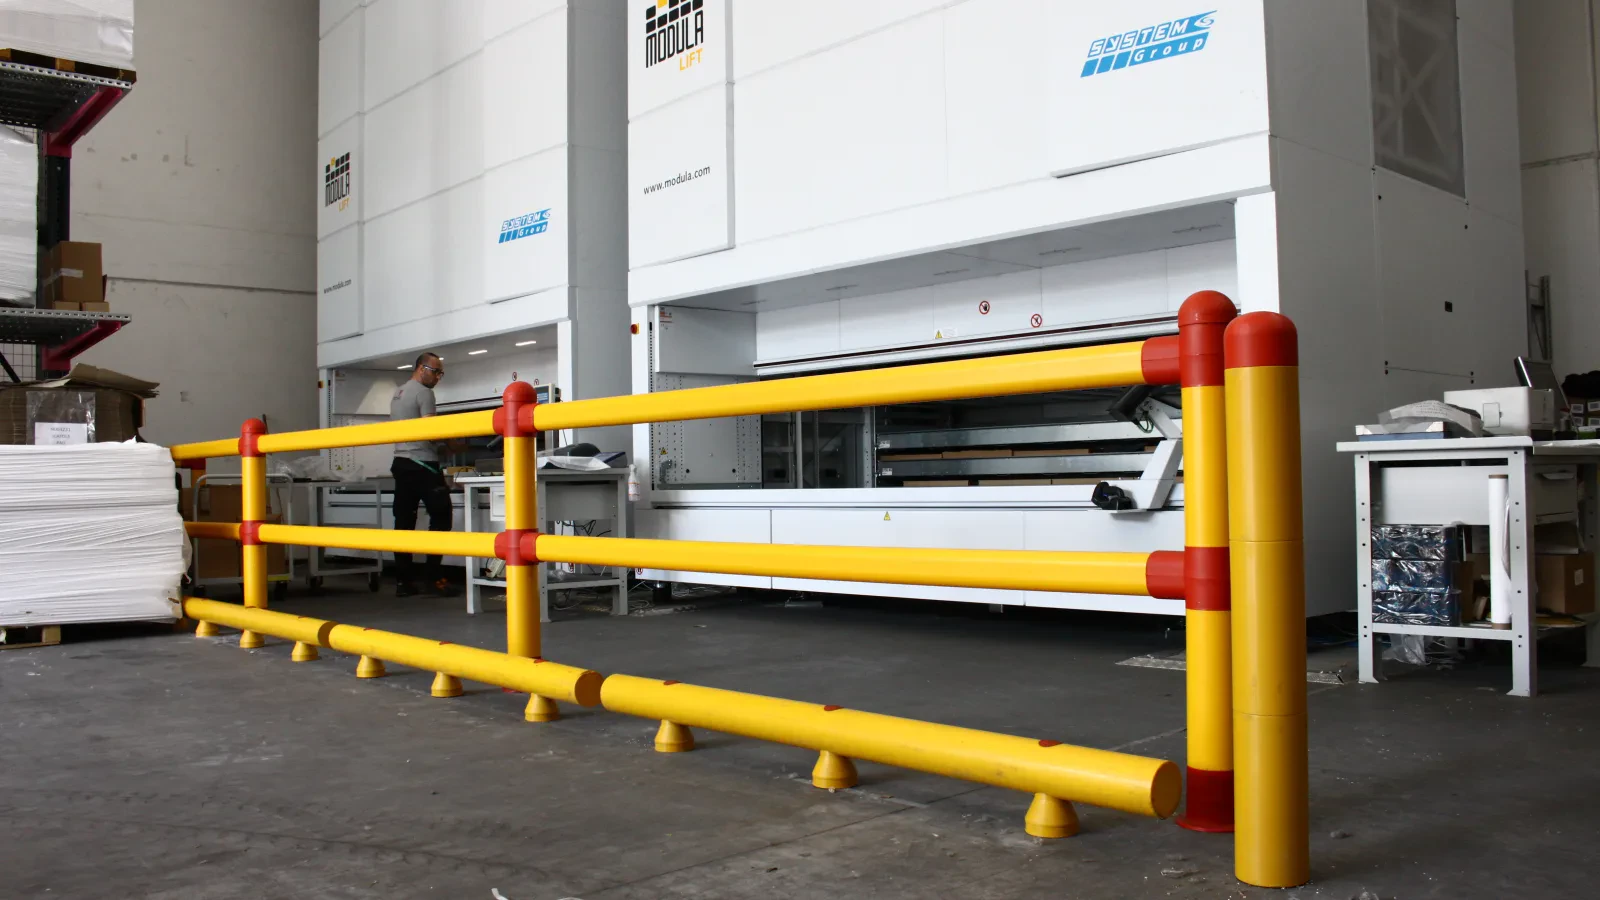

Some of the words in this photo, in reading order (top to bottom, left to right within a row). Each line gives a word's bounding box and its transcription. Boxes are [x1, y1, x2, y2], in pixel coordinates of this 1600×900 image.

[645, 10, 704, 68] MODULA
[1087, 18, 1191, 58] SYSTEM
[1133, 38, 1204, 62] Group
[679, 48, 703, 71] LIFT
[643, 166, 711, 195] www.modula.com
